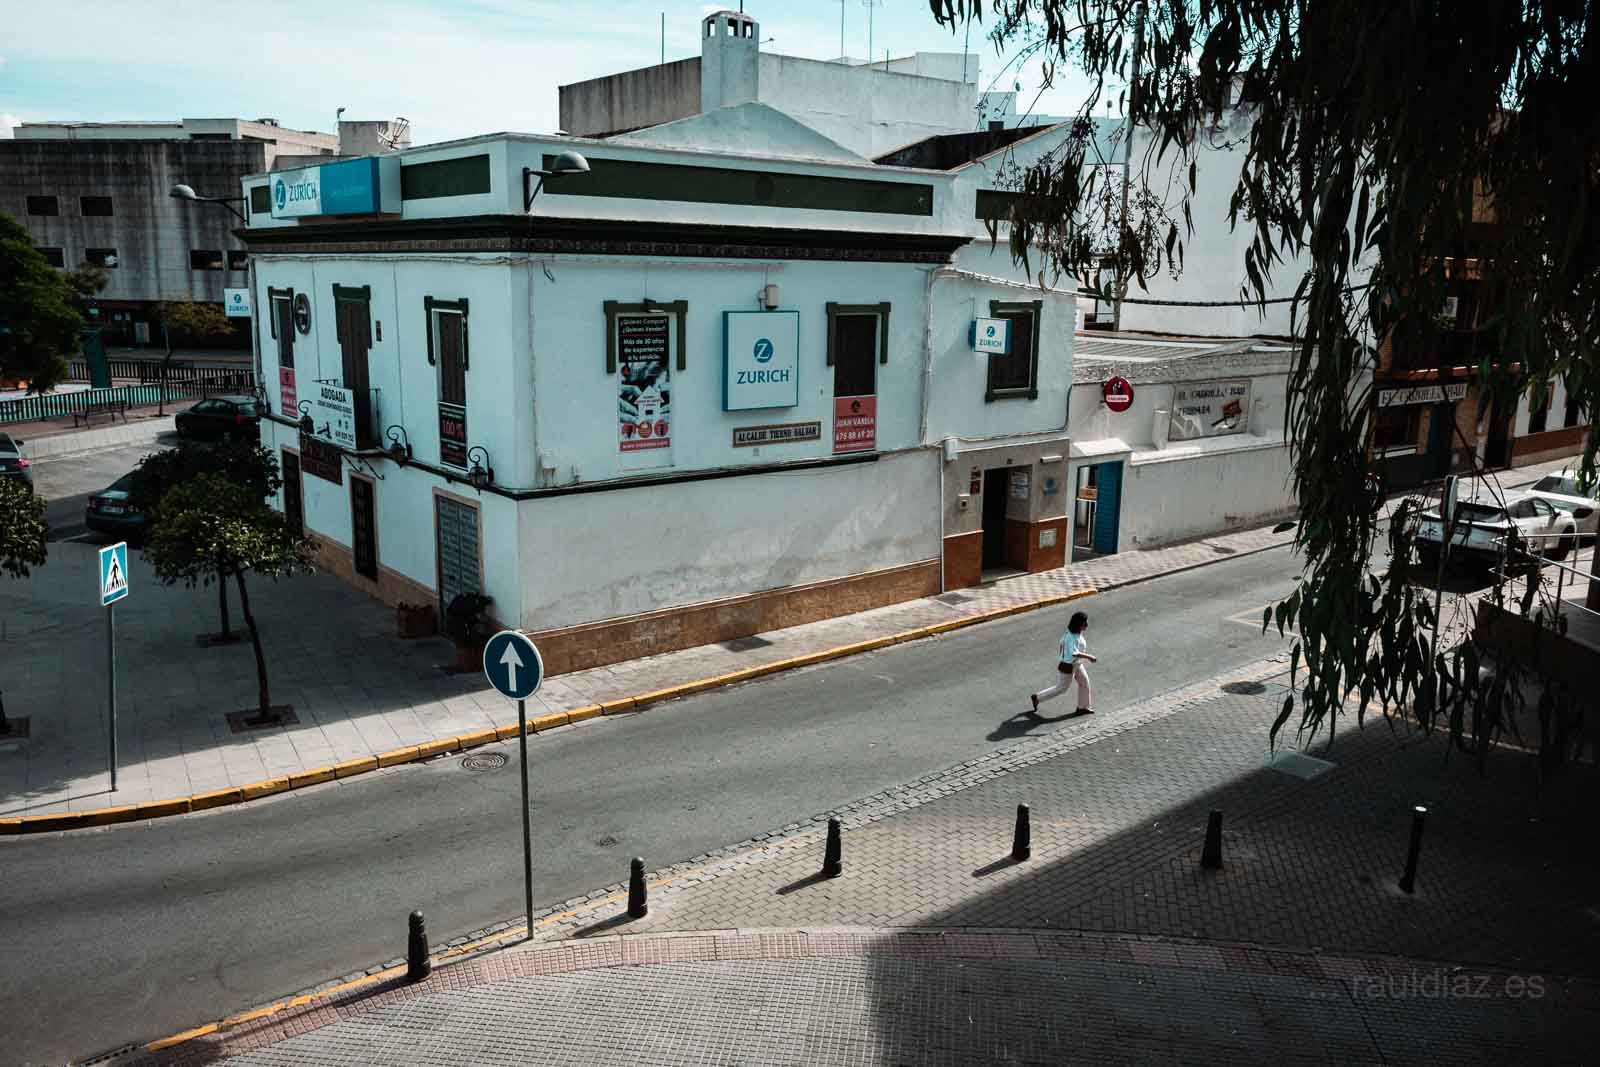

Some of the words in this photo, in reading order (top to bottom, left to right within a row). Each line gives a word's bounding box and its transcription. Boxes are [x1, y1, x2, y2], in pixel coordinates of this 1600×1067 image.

[288, 183, 318, 202] ZURICH
[979, 339, 1002, 347] ZURICH
[737, 370, 790, 385] ZURICH
[321, 387, 346, 402] ABOGADA
